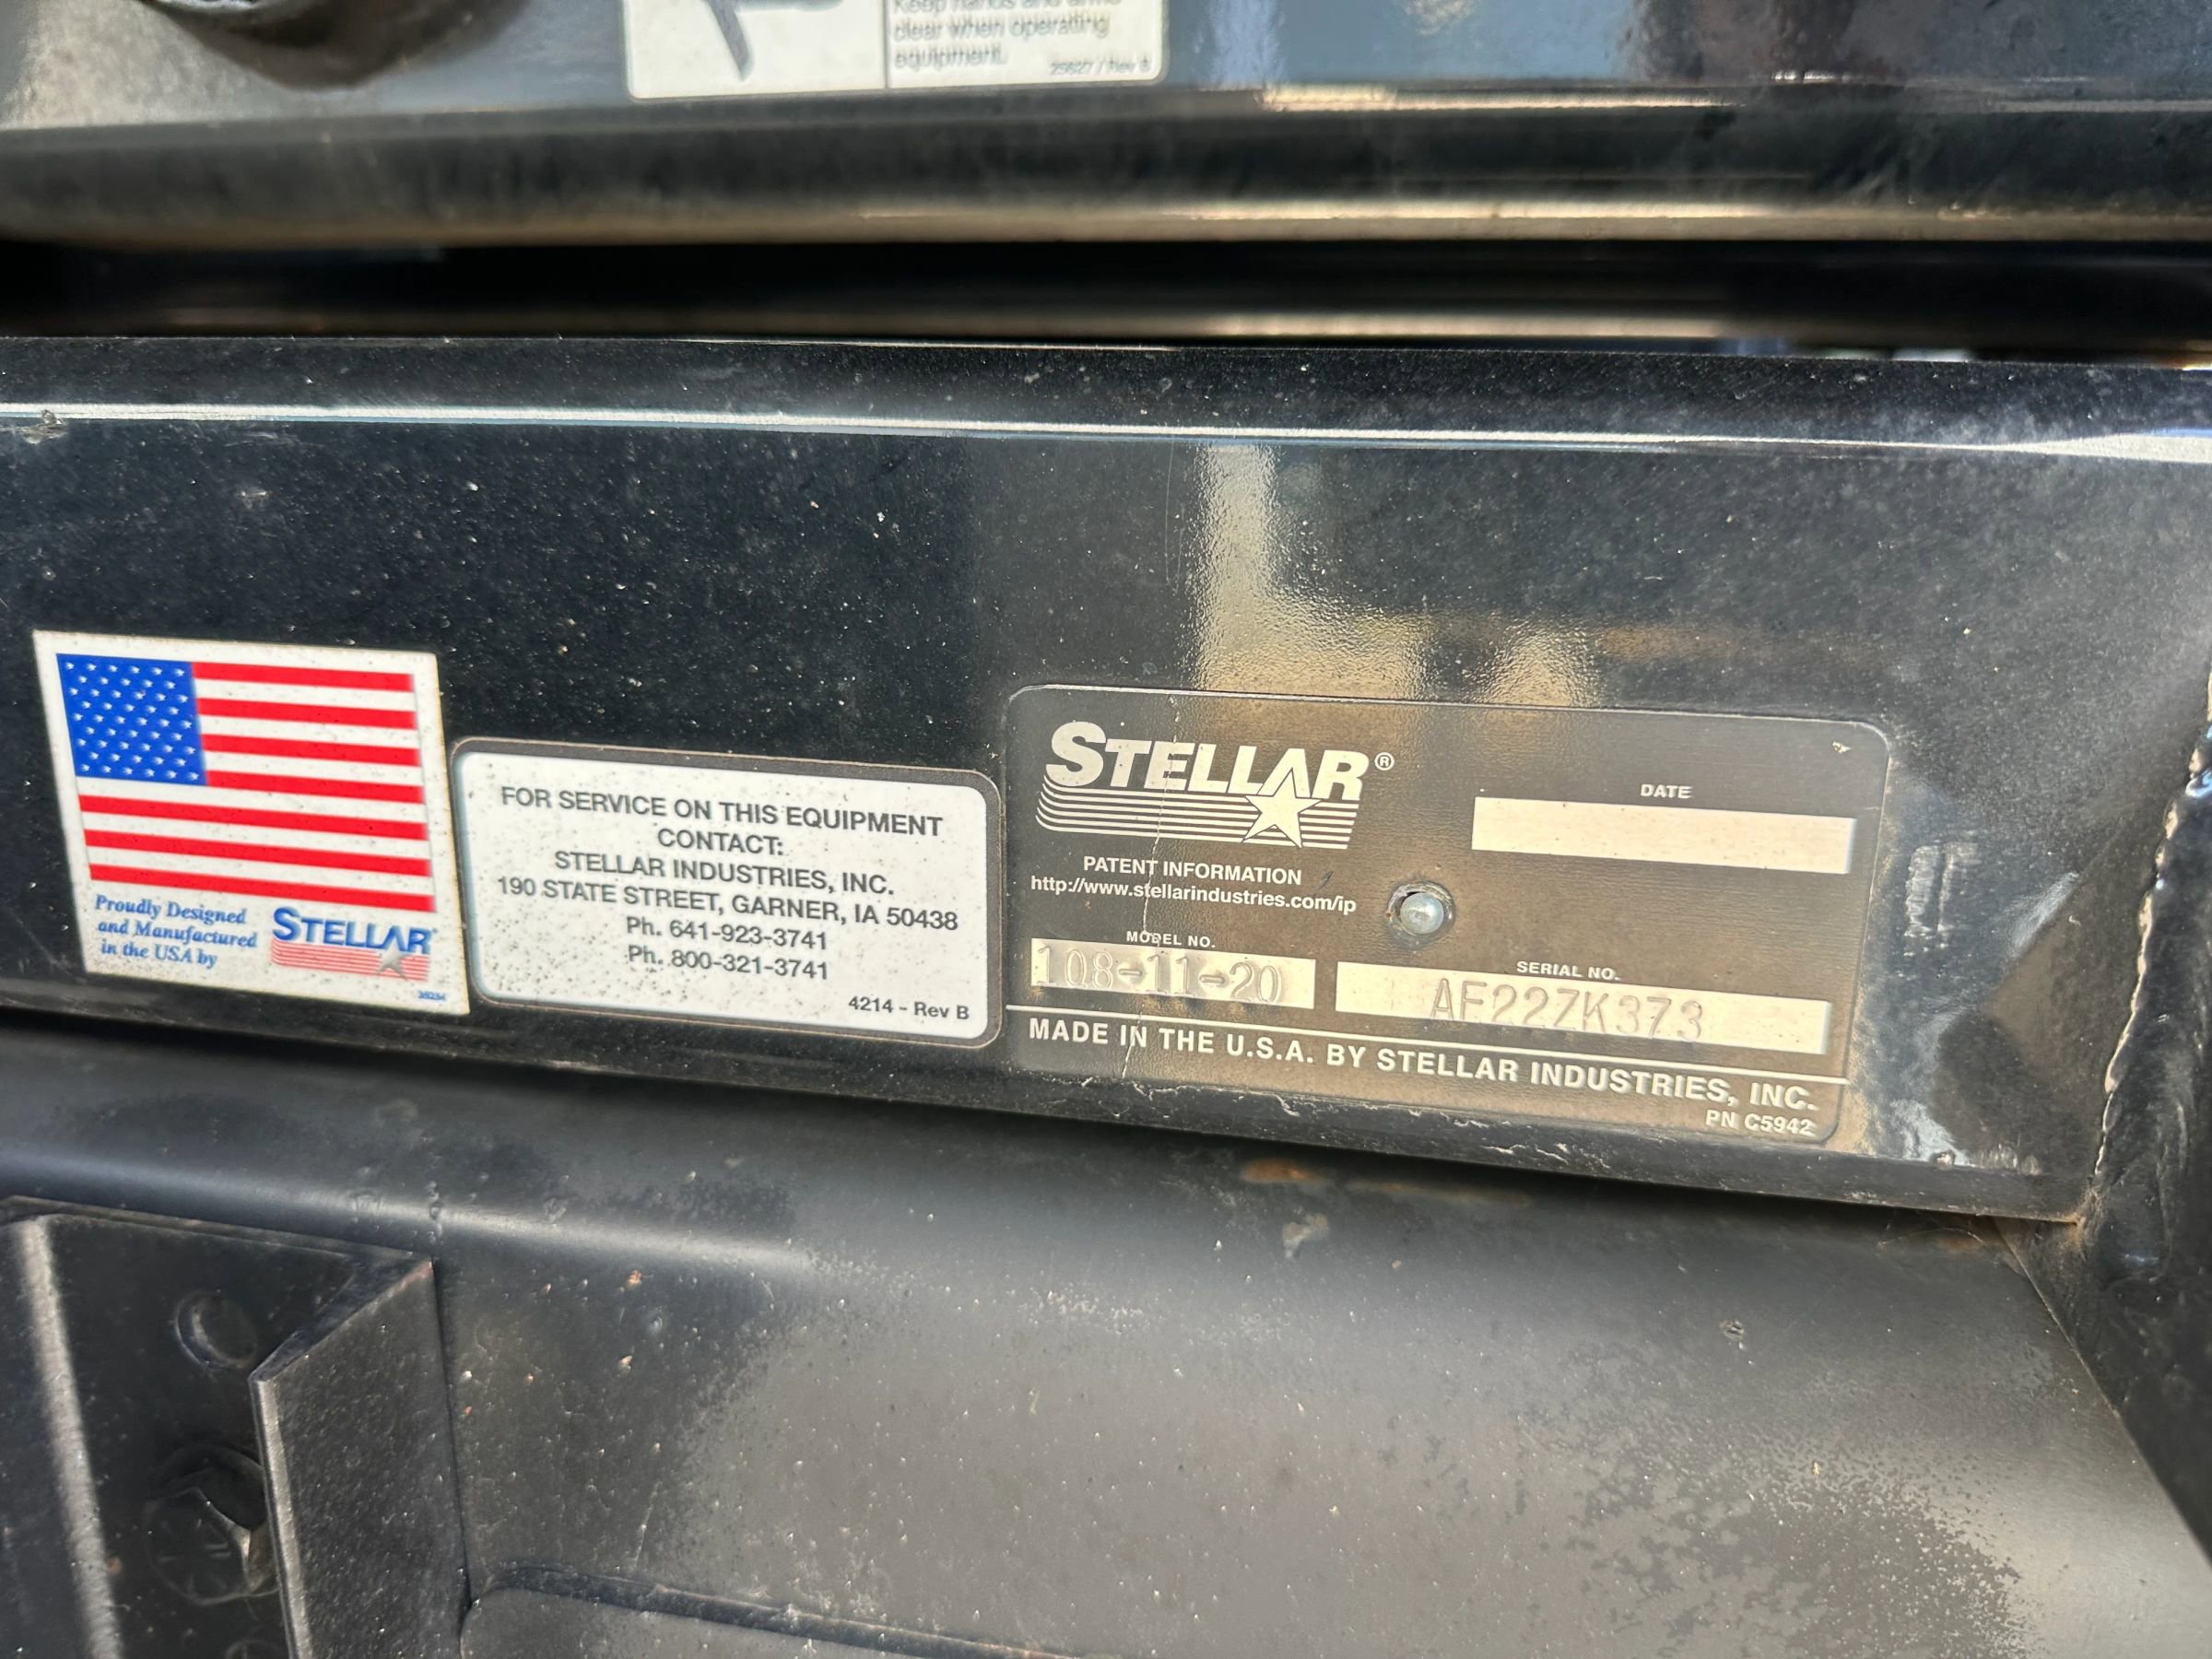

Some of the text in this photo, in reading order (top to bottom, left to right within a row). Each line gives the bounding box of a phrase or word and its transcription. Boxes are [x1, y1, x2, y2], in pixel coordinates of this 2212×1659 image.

[949, 13, 1005, 38] when
[1010, 10, 1110, 41] operating
[1641, 783, 1692, 800] DATE
[501, 786, 942, 837] FOR SERVICE ON THIS EQUIPMENT
[657, 829, 783, 855] CONTACT:
[555, 851, 894, 895] STELLAR INDUSTRIES, INC.
[1084, 855, 1301, 886] PATENT INFORMATION
[95, 894, 247, 925] Proudly Designed
[497, 878, 959, 931] 190 STATE STREET, GARNER, IA 50438
[1031, 876, 1357, 915] http://www.stellarindustries.com/ip
[98, 919, 259, 948] and Manufactured
[627, 917, 828, 950] Ph. 641-923-3741
[1126, 930, 1216, 948] MODEL NO.
[100, 938, 218, 969] in the USA by
[628, 946, 828, 980] Ph. 800-321-3741
[1036, 945, 1283, 1004] 108-11-20
[1516, 961, 1621, 982] SERIAL NO.
[849, 995, 892, 1014] 4214
[914, 1003, 950, 1020] Rev
[957, 1005, 970, 1020] B
[1030, 1018, 1819, 1111] MADE IN THE U.S.A. BY STELLAR INDUSTRIES, INC.
[1705, 1110, 1818, 1136] PN C5942
